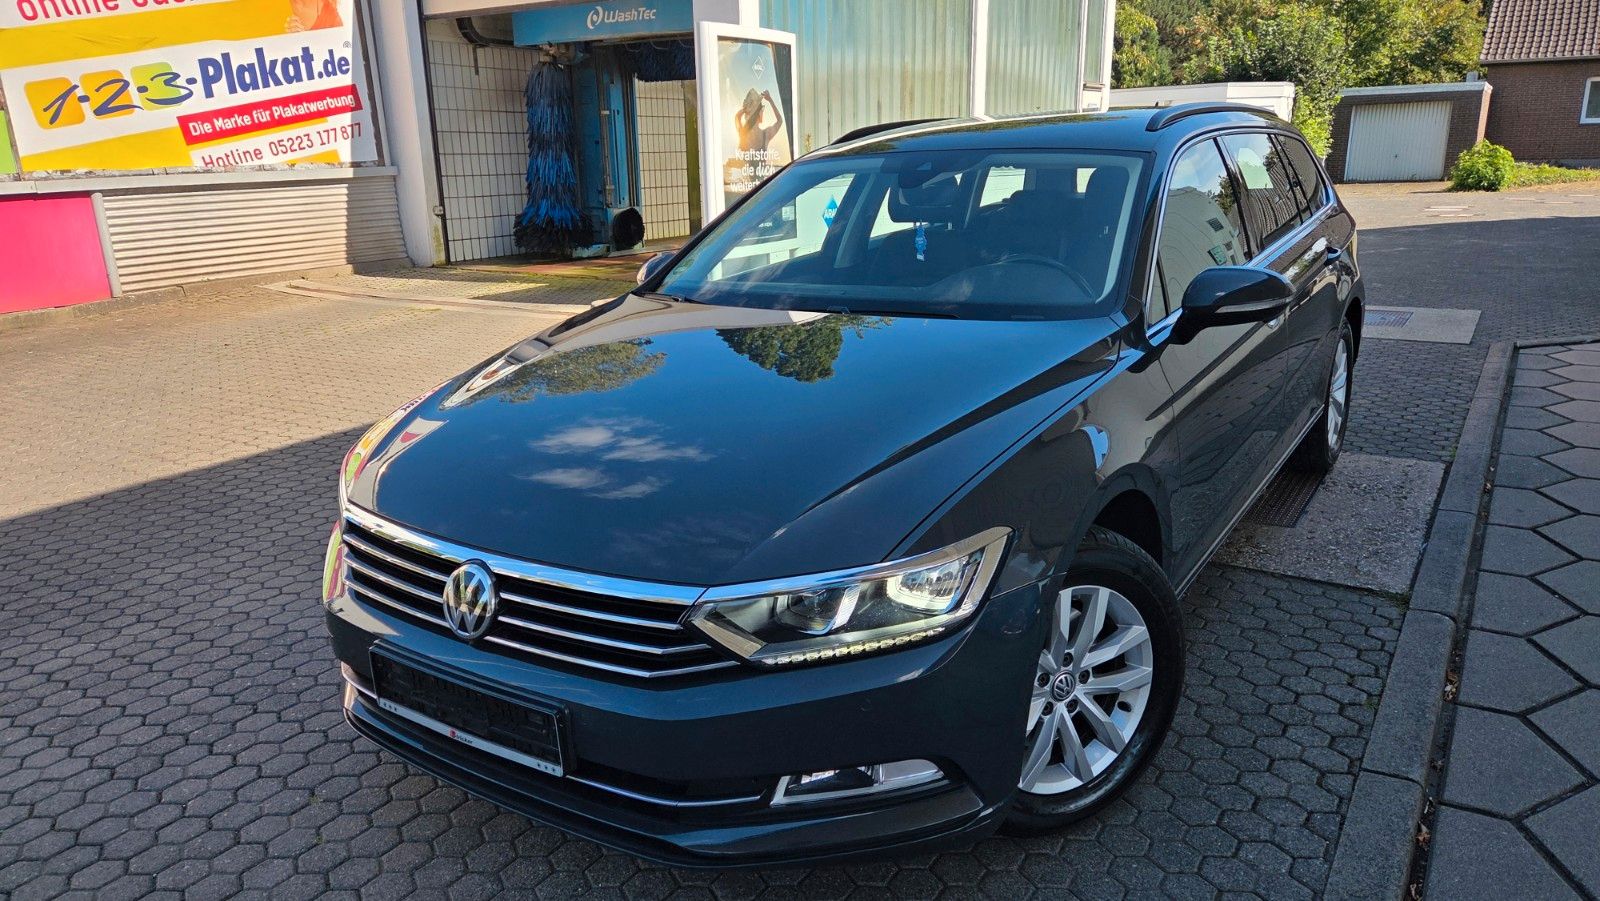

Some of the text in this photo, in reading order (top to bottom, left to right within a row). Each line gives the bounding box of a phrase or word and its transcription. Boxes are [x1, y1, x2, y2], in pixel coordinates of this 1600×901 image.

[604, 8, 657, 23] WashTec
[188, 94, 356, 136] Die Marke für Plakatwerbung
[201, 122, 362, 168] Hotline 05223 177 877
[741, 161, 777, 177] die dich
